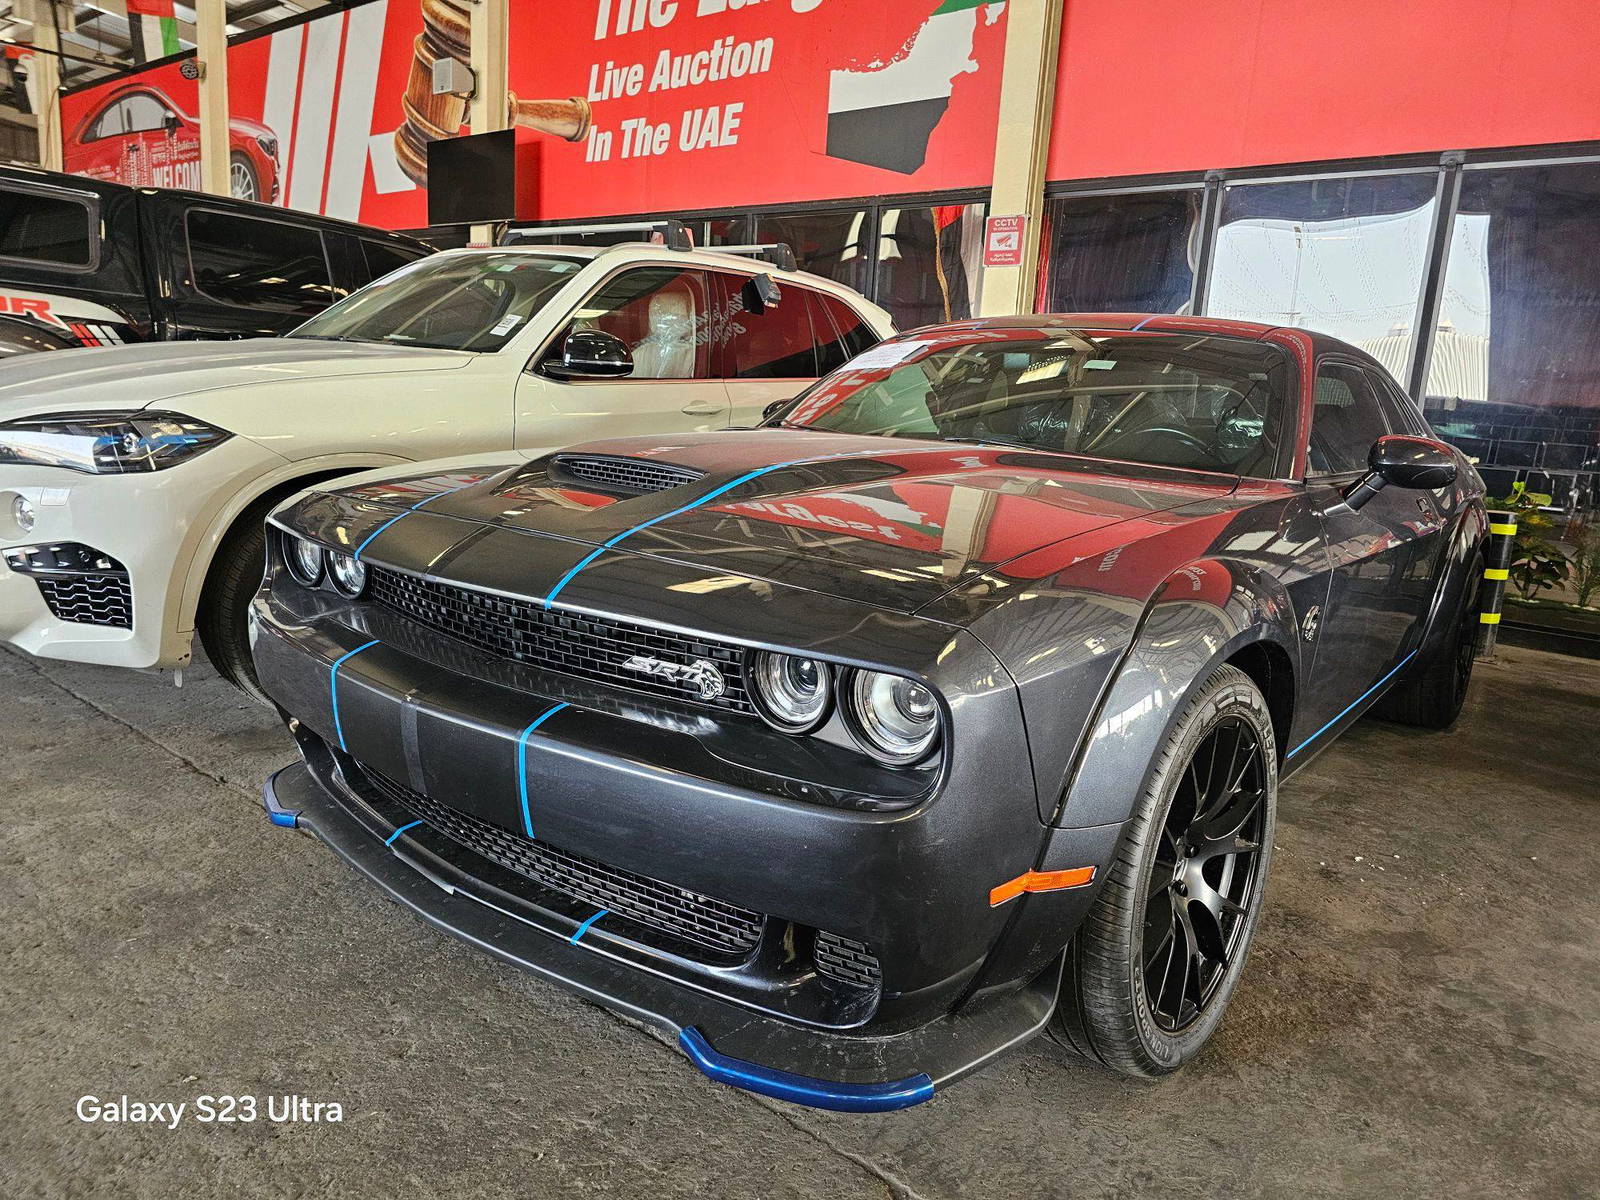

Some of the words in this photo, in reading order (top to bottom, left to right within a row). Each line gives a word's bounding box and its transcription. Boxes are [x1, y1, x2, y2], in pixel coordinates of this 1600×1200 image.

[587, 61, 644, 102] Live
[648, 36, 774, 92] Auction
[585, 125, 613, 162] In
[620, 117, 670, 159] The
[679, 102, 744, 151] UAE
[994, 218, 1018, 227] CCTV
[622, 655, 703, 682] SRT
